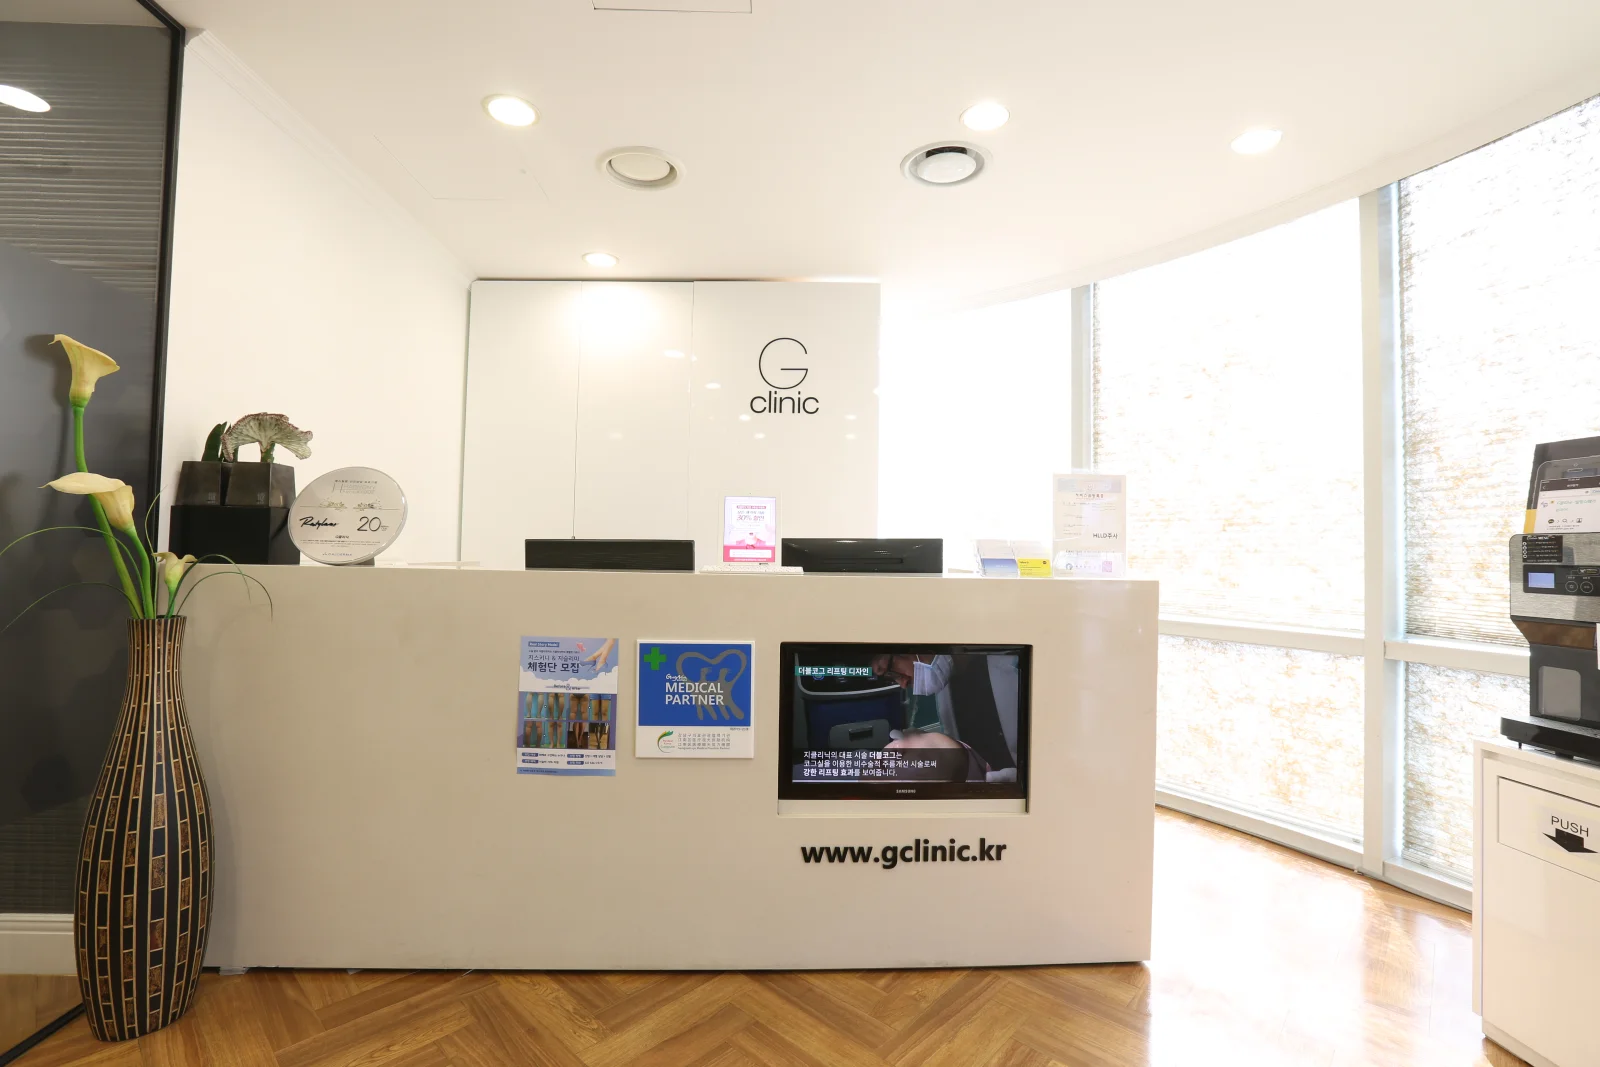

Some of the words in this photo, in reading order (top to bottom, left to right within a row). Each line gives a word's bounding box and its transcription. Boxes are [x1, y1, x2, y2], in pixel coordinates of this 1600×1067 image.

[758, 337, 809, 390] G
[749, 390, 820, 415] clinic
[356, 516, 382, 532] 20
[527, 661, 558, 673] 체험단
[560, 662, 580, 674] 모집
[798, 666, 825, 675] 더블코그
[827, 667, 847, 675] 리프팅
[849, 667, 869, 676] 디자인
[665, 682, 724, 693] MEDICAL
[665, 694, 724, 706] PARTNER
[803, 751, 838, 759] 지클리닉의
[838, 751, 853, 759] 대표
[854, 751, 868, 760] 시술
[869, 751, 903, 760] 더블코그는
[803, 759, 831, 768] 코그실을
[832, 759, 853, 768] 이용한
[854, 760, 881, 768] 비수술적
[882, 760, 909, 769] 주름개선
[910, 760, 937, 769] 시술로써
[803, 768, 817, 777] 강한
[818, 768, 839, 777] 리프팅
[840, 768, 861, 777] 효과를
[1550, 815, 1589, 838] PUSH
[800, 837, 1007, 870] www.gclinic.kr
